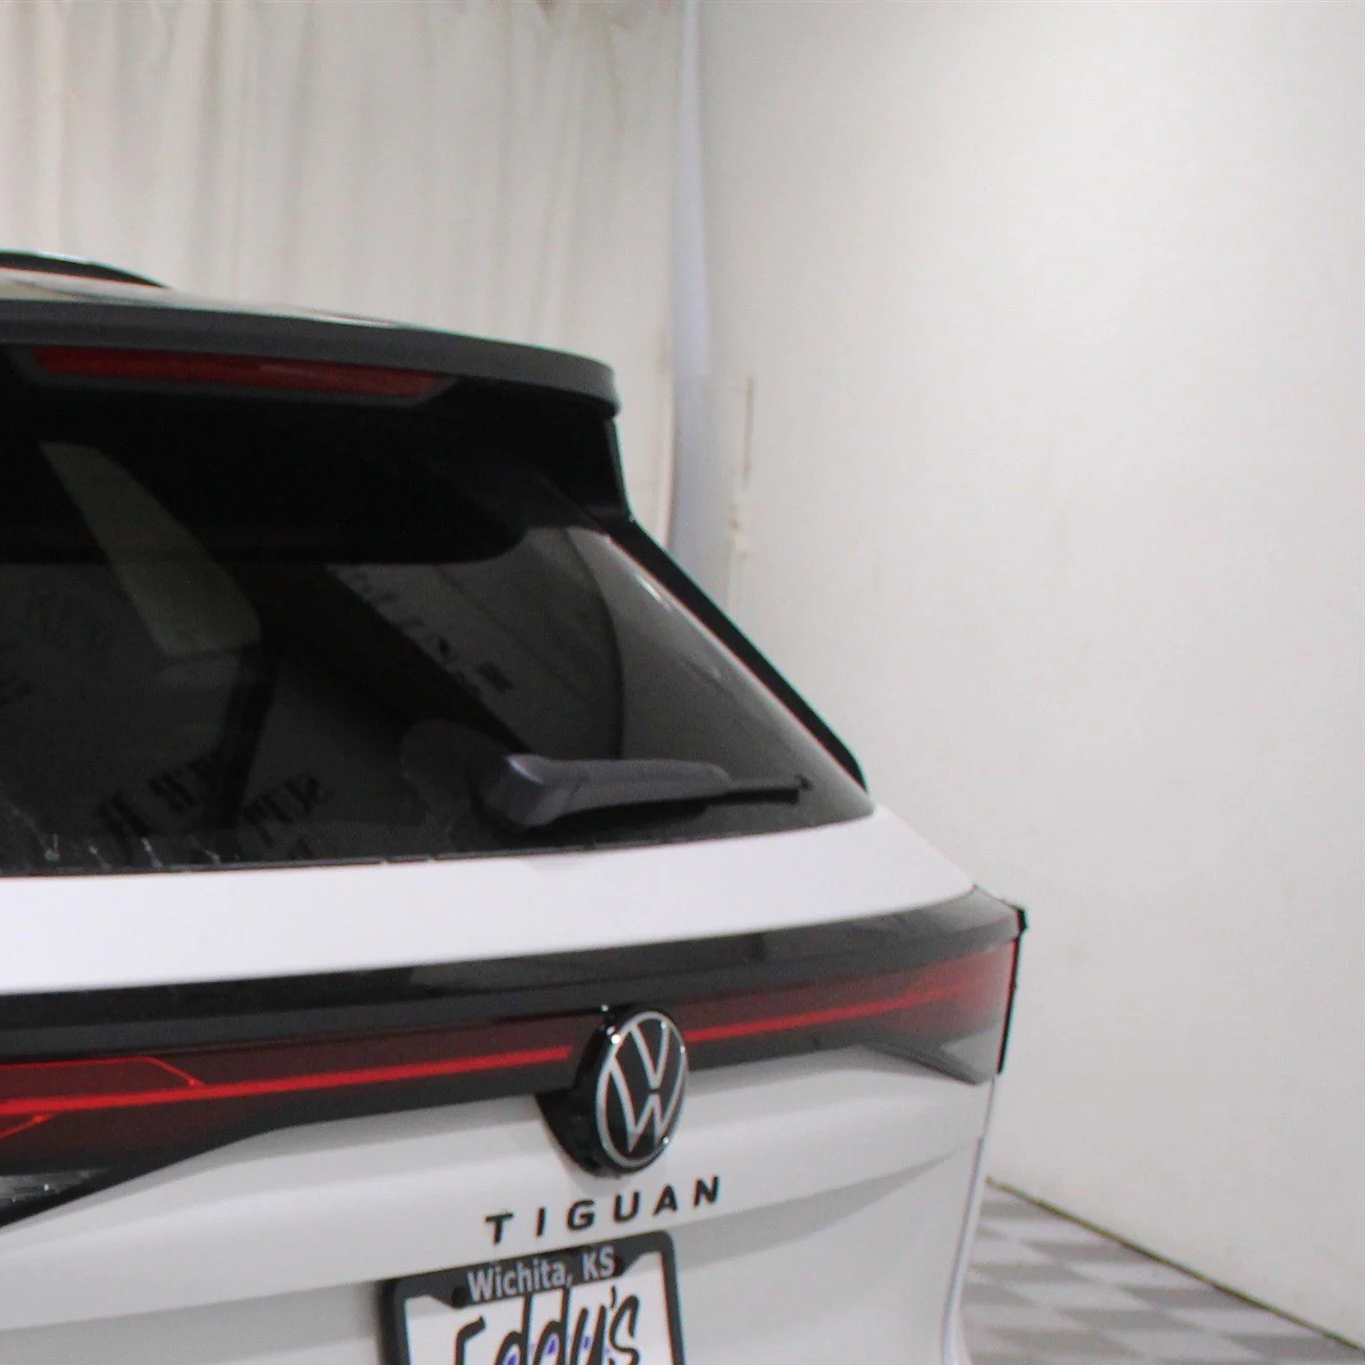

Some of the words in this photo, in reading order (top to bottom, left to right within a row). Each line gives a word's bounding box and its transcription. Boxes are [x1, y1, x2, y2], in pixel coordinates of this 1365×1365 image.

[485, 1175, 720, 1246] TIGUAN
[467, 1257, 573, 1303] Wichita,
[582, 1246, 616, 1282] KS
